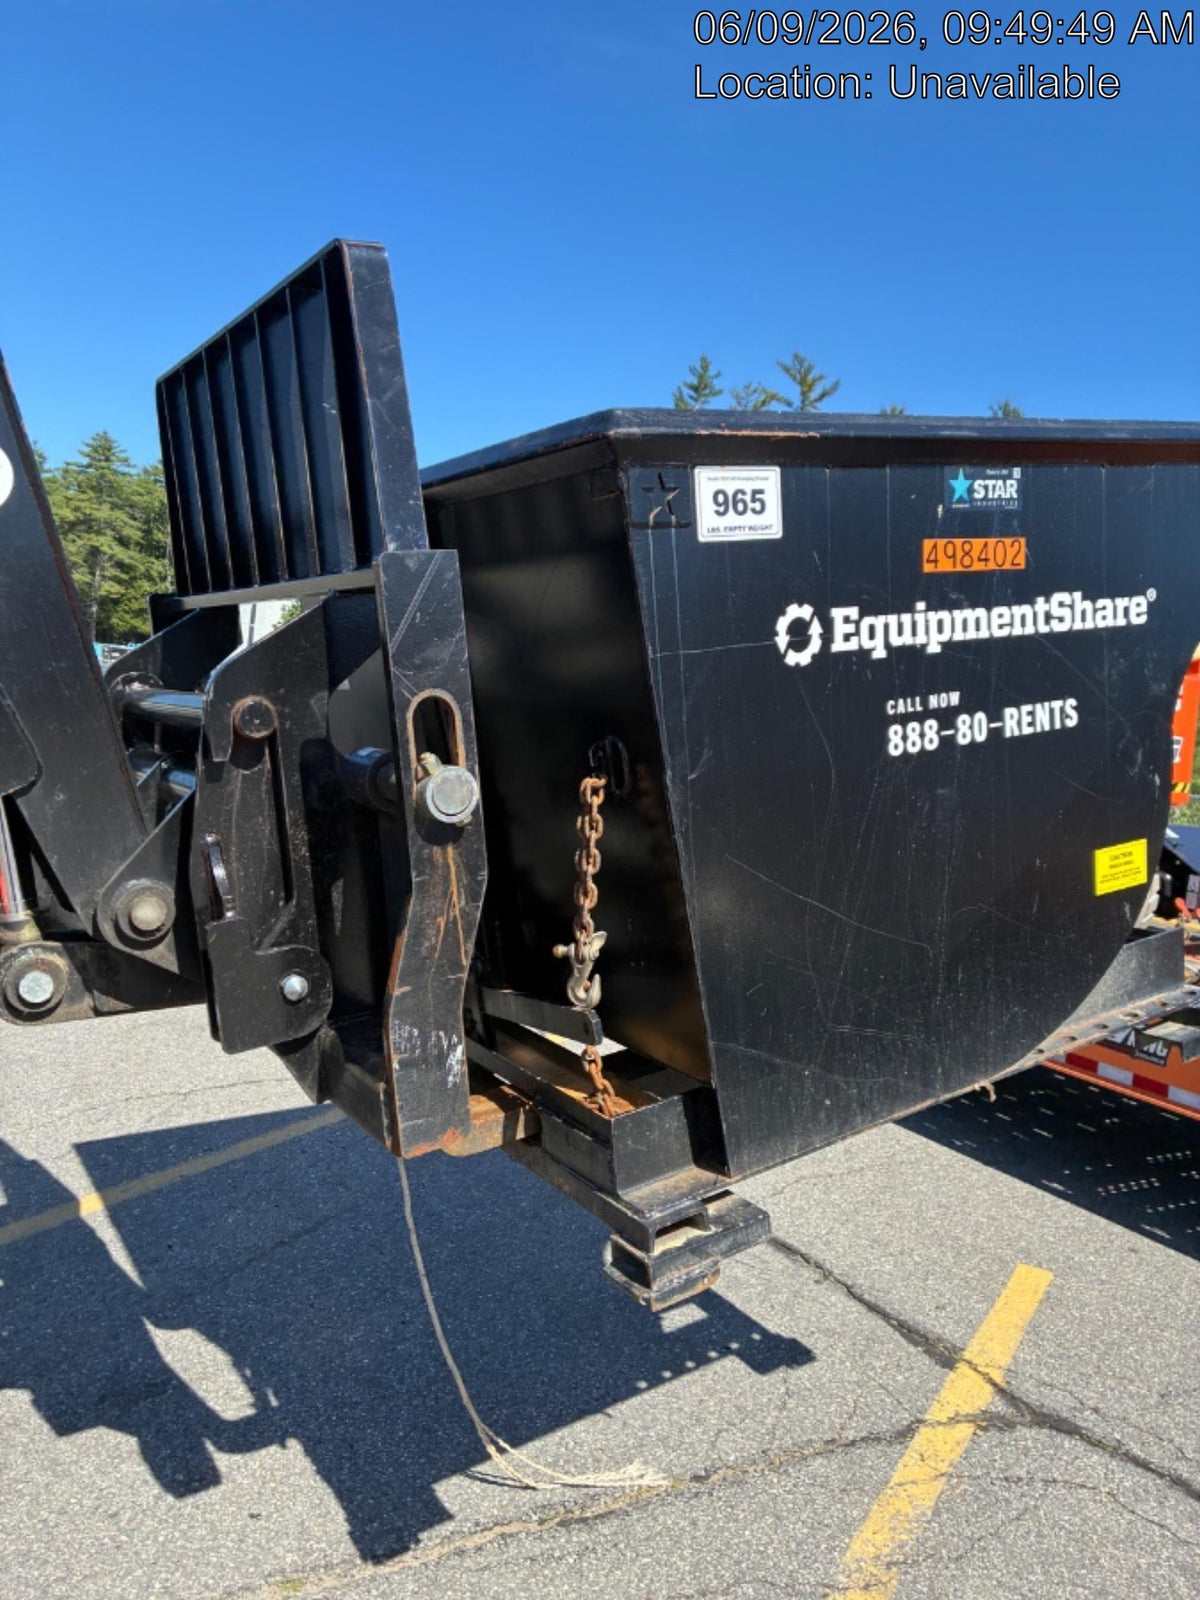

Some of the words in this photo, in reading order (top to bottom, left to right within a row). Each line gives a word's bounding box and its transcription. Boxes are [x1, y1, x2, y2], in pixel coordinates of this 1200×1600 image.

[712, 488, 766, 517] 965
[973, 479, 1018, 499] STAR
[926, 539, 1022, 569] 498402
[886, 698, 924, 716] CALL
[929, 690, 961, 709] NOW
[886, 697, 1079, 757] 888-80-RENTS
